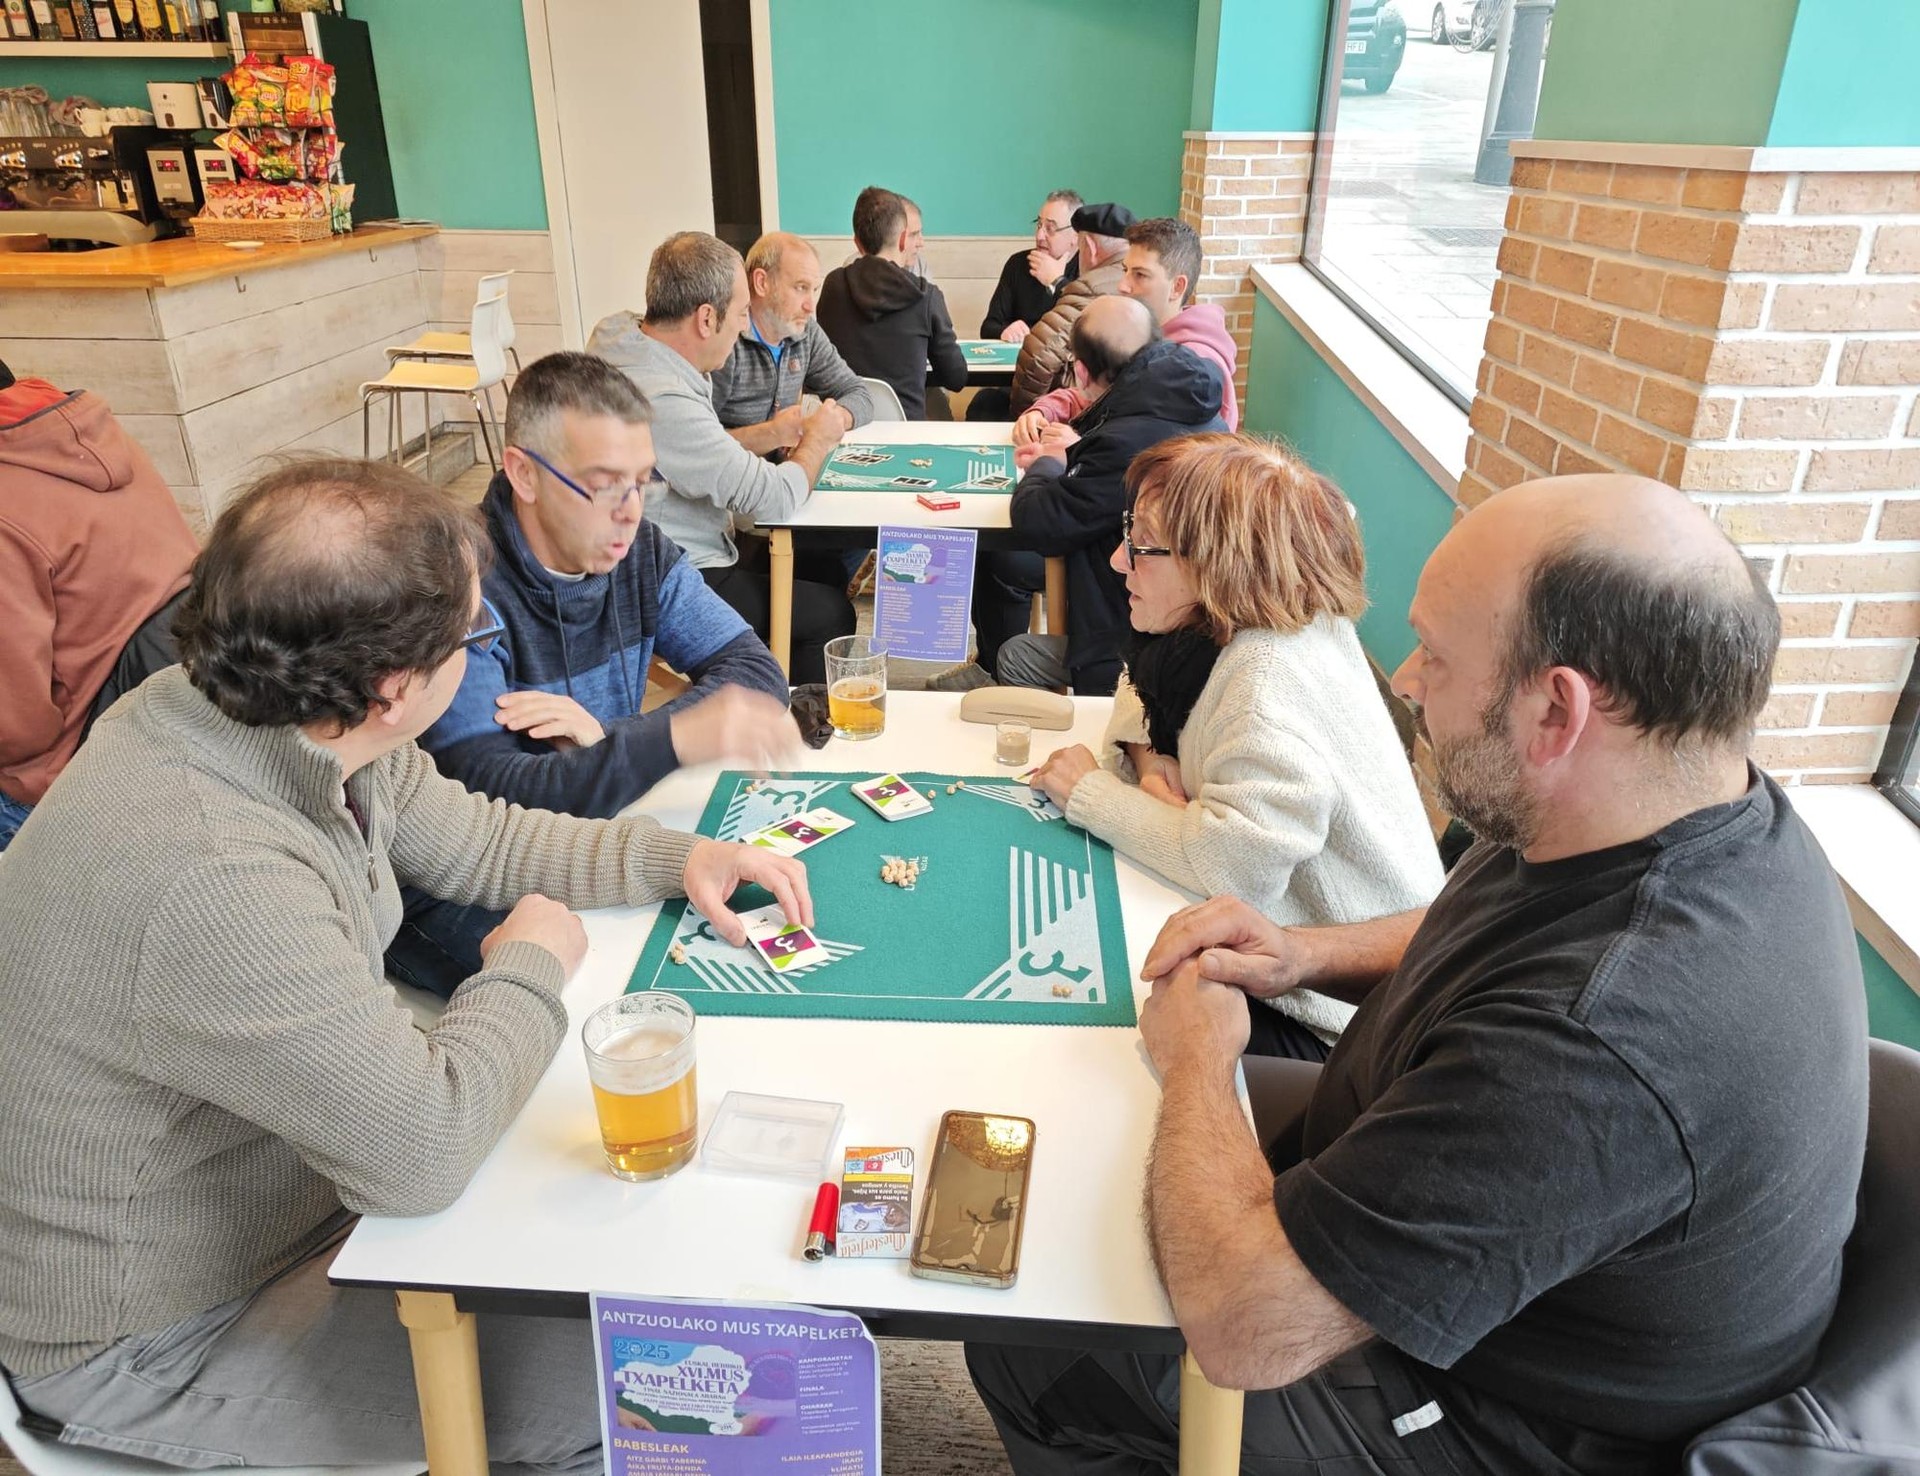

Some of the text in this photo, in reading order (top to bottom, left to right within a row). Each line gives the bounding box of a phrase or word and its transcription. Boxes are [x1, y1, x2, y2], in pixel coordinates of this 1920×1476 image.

[841, 1233, 906, 1258] Chesterfield
[602, 1310, 717, 1332] ANTZUOLAKO
[723, 1321, 760, 1335] MUS
[615, 1340, 670, 1359] 2025
[622, 1370, 740, 1395] TXAPELKETA
[614, 1438, 689, 1454] BABESLEAK
